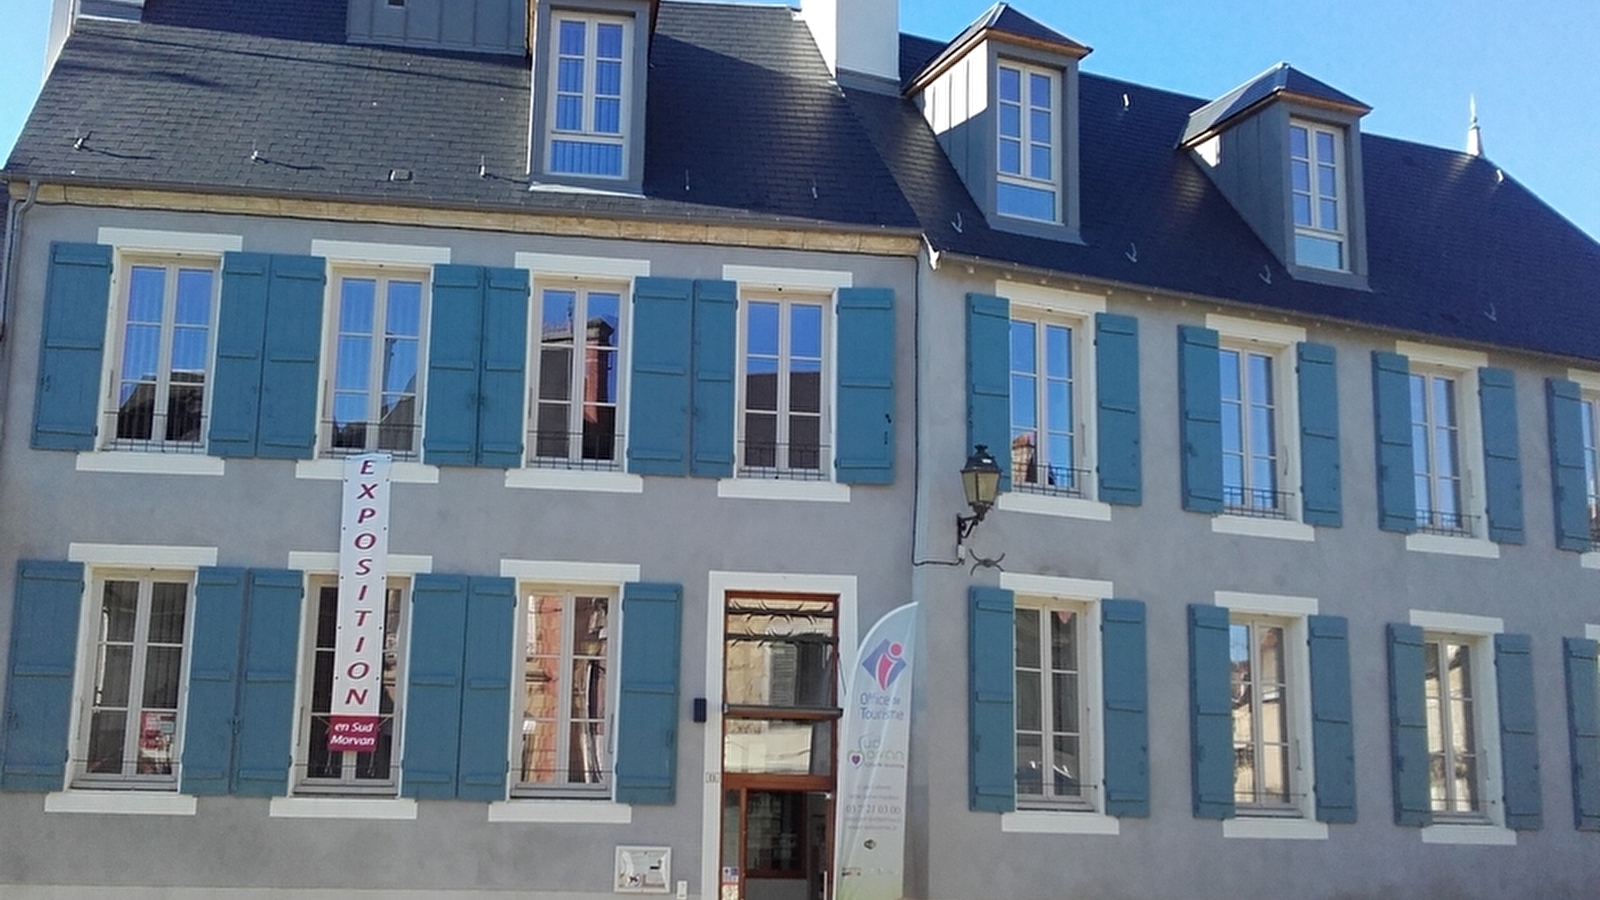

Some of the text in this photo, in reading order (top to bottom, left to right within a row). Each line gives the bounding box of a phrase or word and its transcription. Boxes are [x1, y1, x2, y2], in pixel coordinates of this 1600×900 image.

[344, 458, 378, 706] EXPOSITION
[860, 691, 890, 706] Office
[860, 707, 904, 721] Tourisme
[333, 721, 374, 732] en Sud
[330, 734, 375, 746] Morvan
